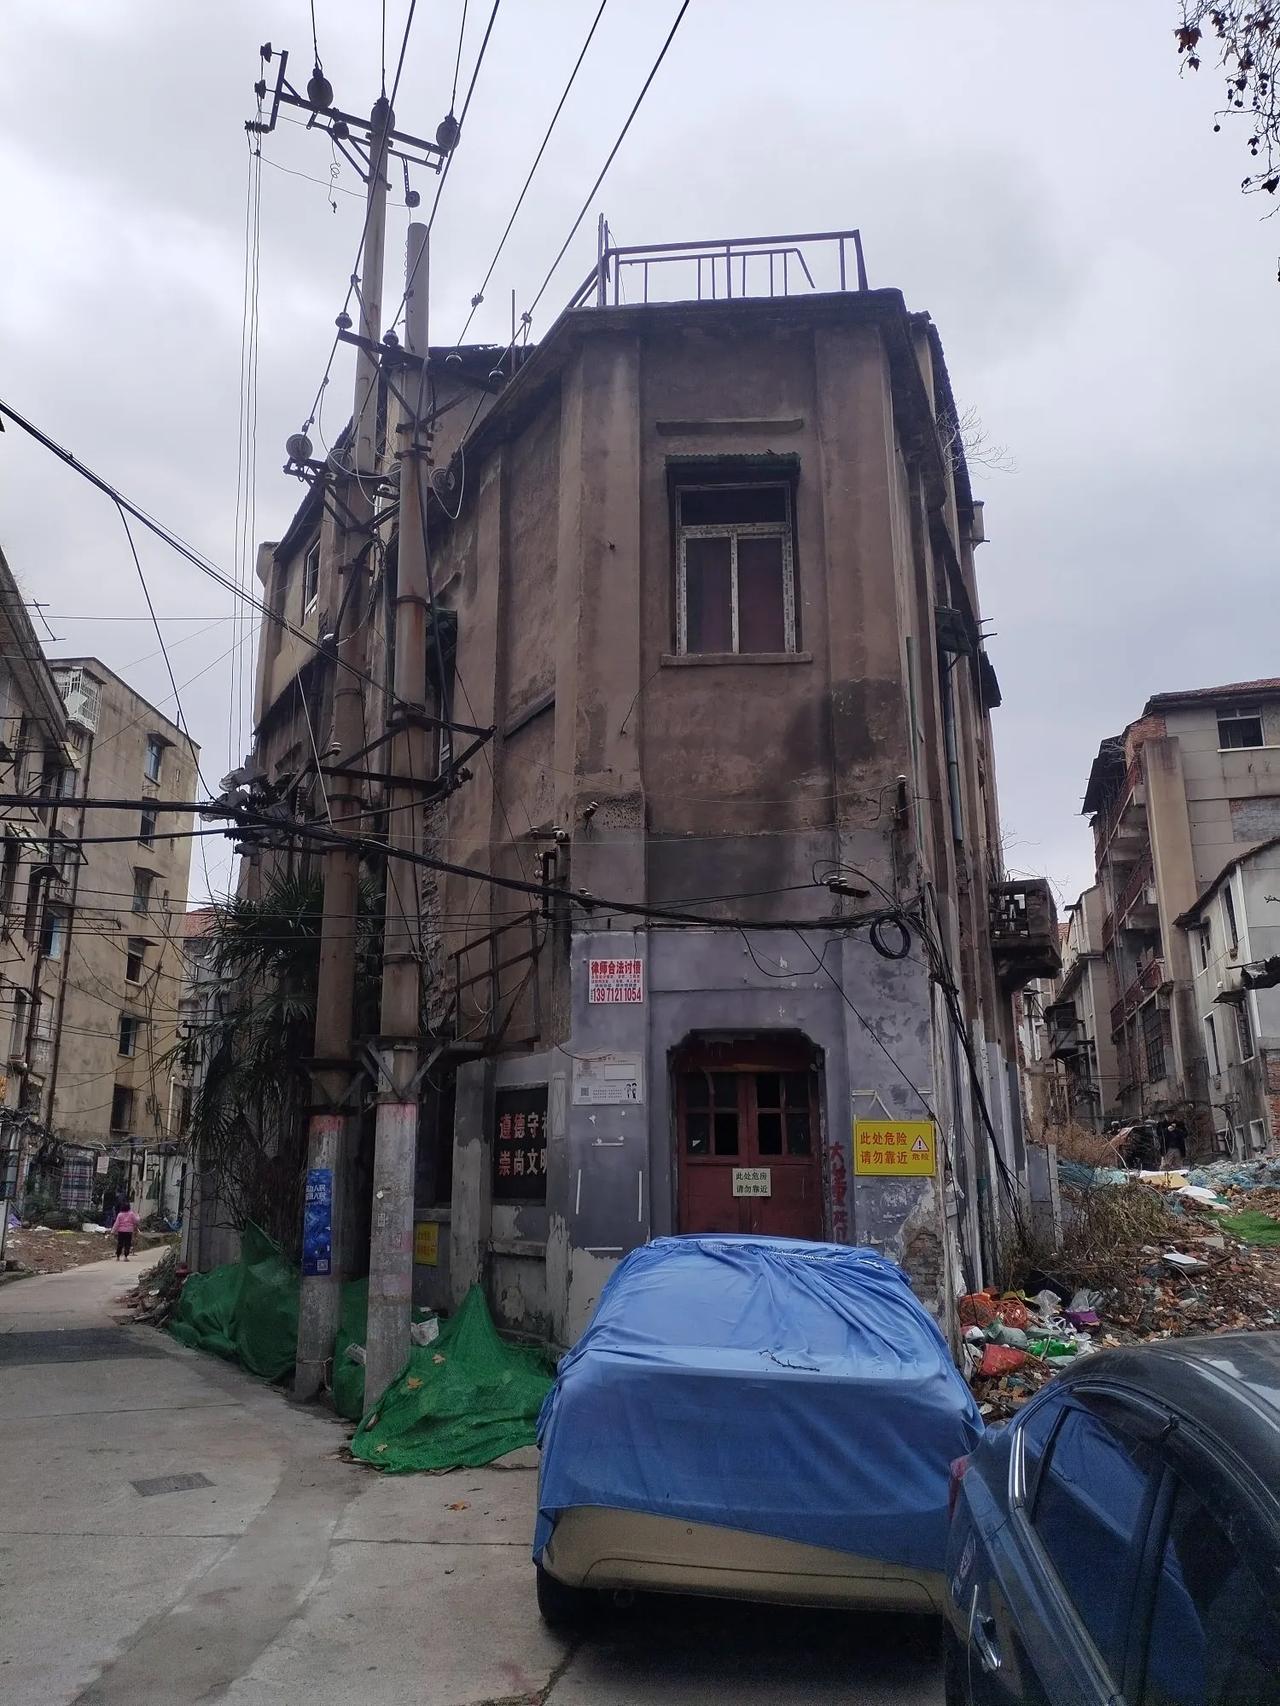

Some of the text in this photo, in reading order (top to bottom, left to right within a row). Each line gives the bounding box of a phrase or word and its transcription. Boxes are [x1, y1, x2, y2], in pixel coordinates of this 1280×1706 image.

[860, 1131, 908, 1146] 此处危险
[860, 1150, 908, 1165] 请勿靠近
[911, 1152, 930, 1161] 危险
[736, 1171, 768, 1181] 此处危房
[736, 1184, 768, 1194] 请勿靠近
